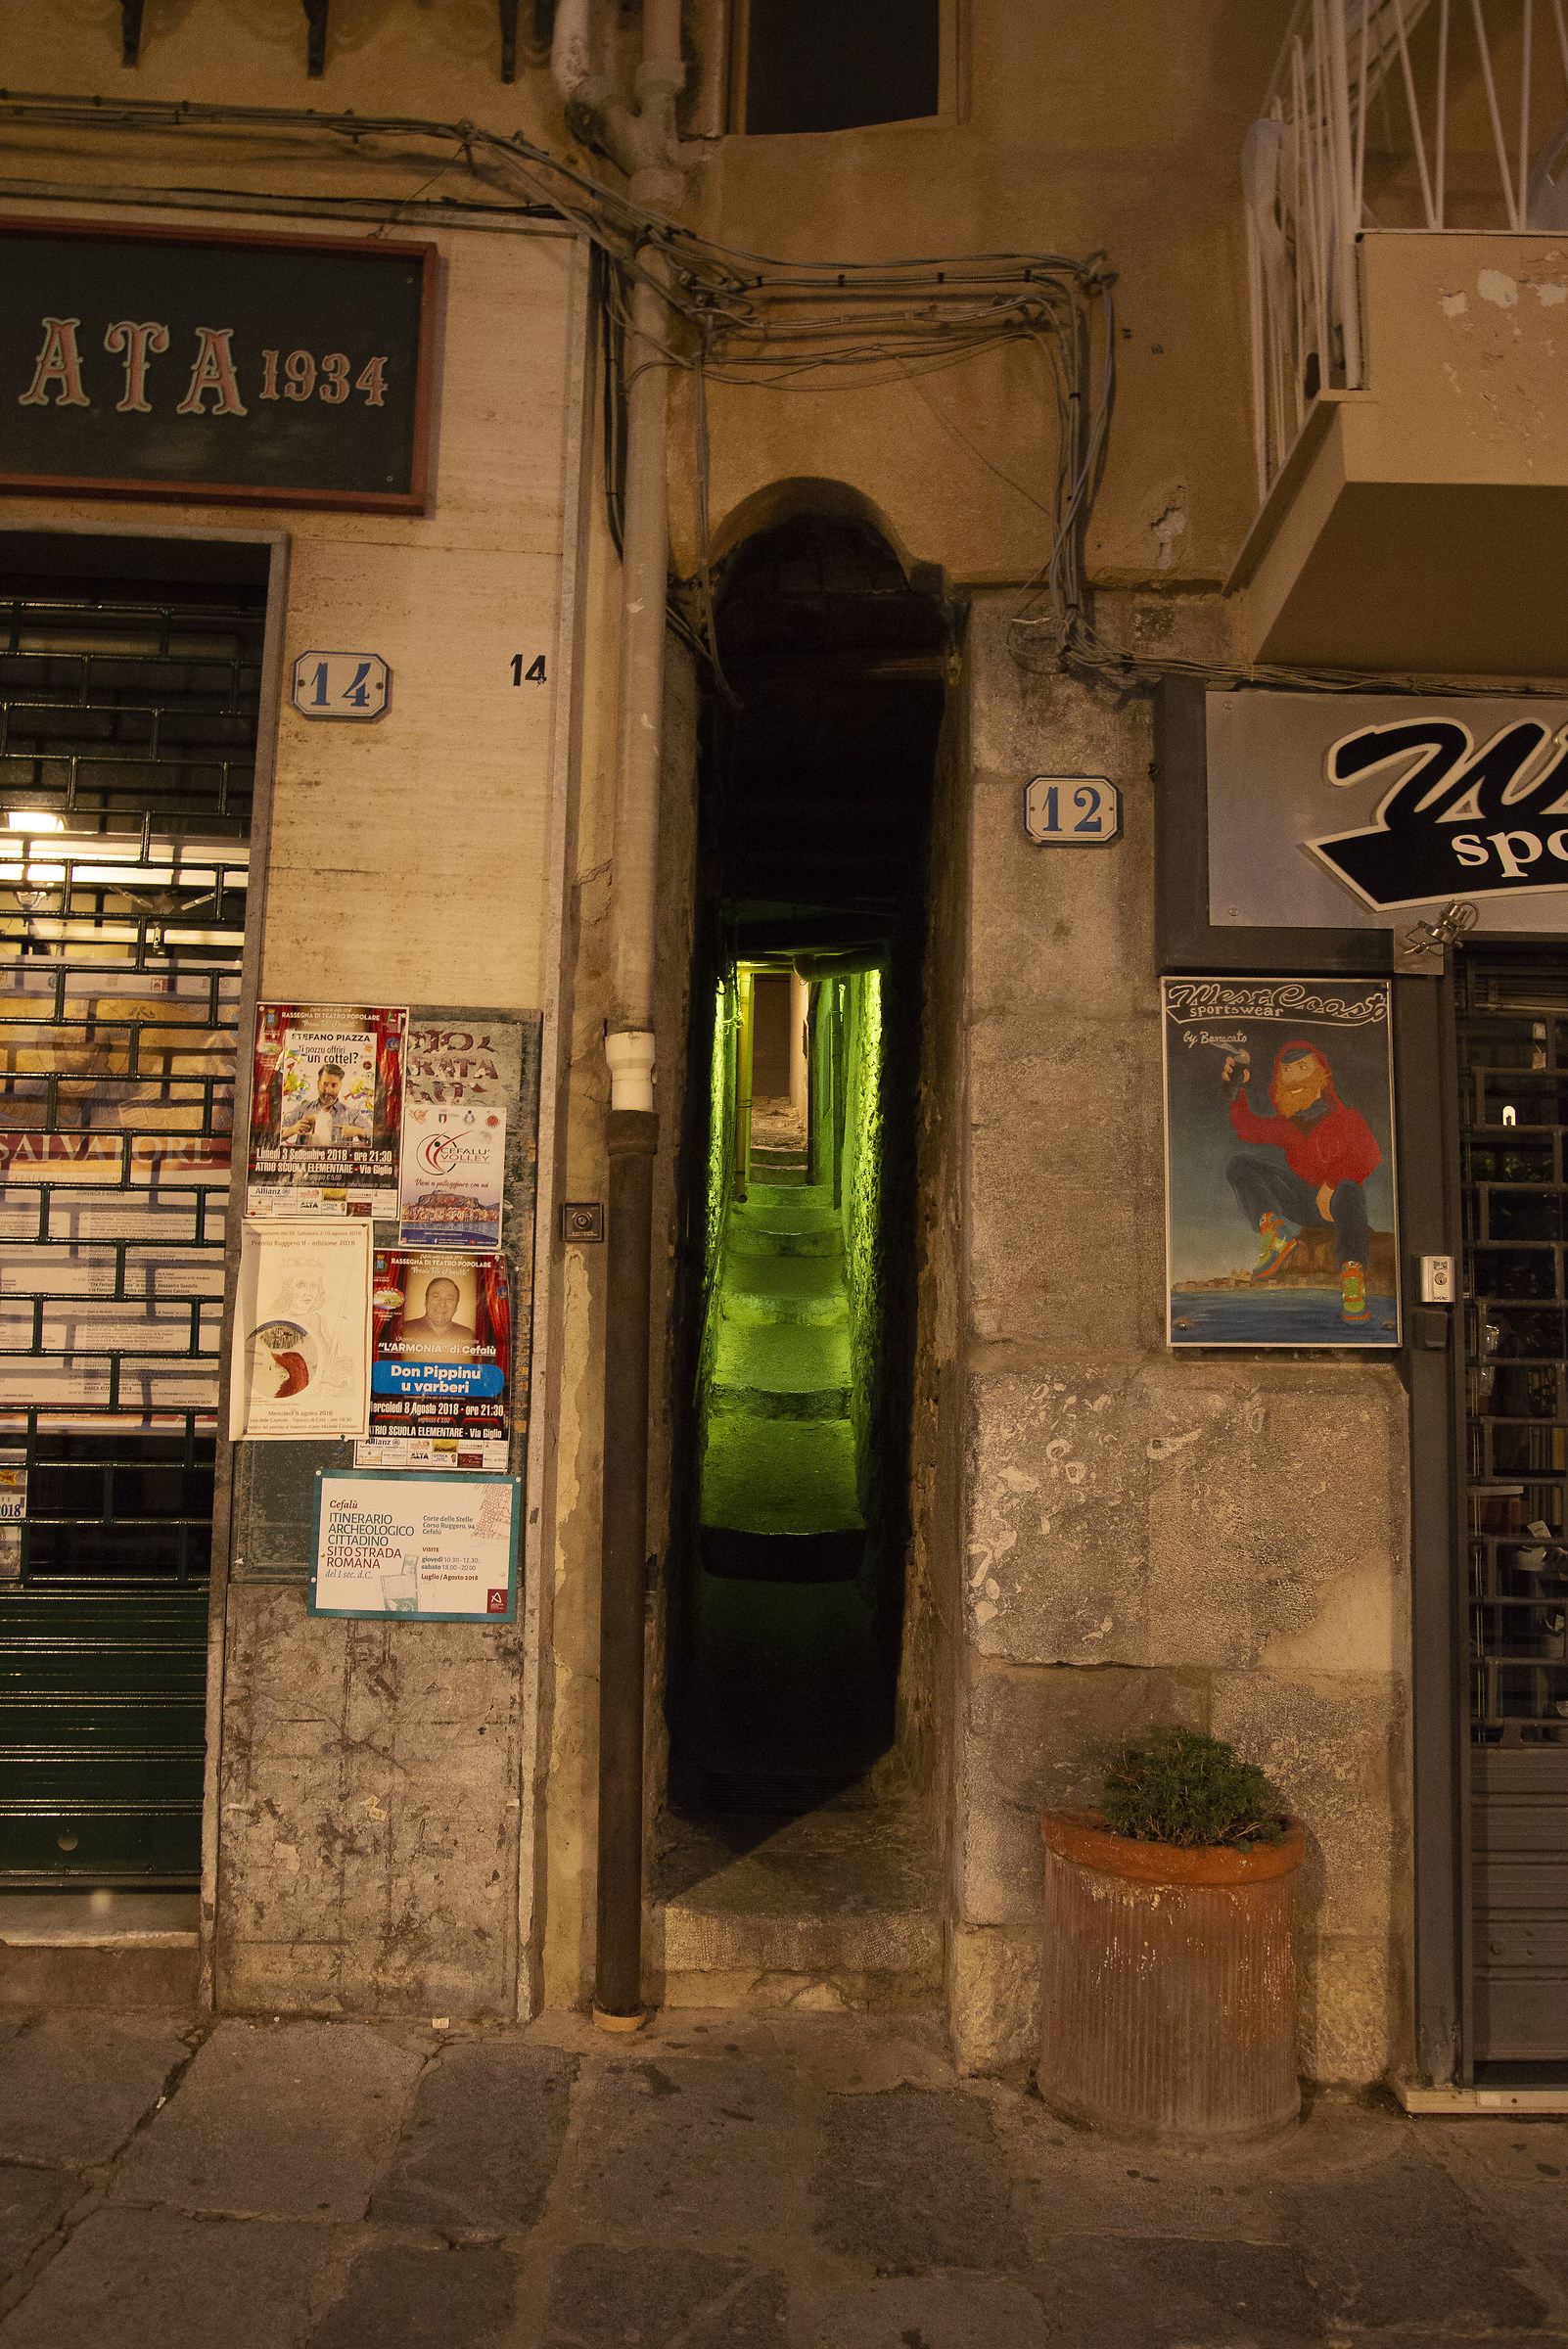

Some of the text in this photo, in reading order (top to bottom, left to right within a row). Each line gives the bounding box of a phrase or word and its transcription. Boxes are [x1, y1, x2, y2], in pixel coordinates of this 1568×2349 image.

[259, 349, 389, 406] 1934
[510, 654, 547, 686] 14
[310, 662, 371, 707] 14
[1042, 786, 1102, 832] 12
[1189, 1005, 1284, 1018] sportswear
[291, 1033, 334, 1041] STEFANO
[1183, 1031, 1198, 1048] by
[324, 1052, 359, 1064] cottel?
[256, 1147, 281, 1160] Lunedì
[282, 1149, 288, 1160] 3
[290, 1149, 325, 1161] Settembre
[327, 1149, 347, 1161] 2018
[353, 1152, 367, 1161] ore
[369, 1150, 392, 1162] 21:30
[255, 1162, 277, 1173] ATRIO
[278, 1163, 306, 1173] SCUOLA
[307, 1163, 353, 1174] ELEMENTARE
[360, 1164, 371, 1174] Via
[373, 1164, 392, 1175] Giglio
[415, 1177, 429, 1186] Vieni
[462, 1346, 496, 1355] Cefalù
[391, 1364, 482, 1380] Don Pippinu
[401, 1380, 470, 1393] u varberi
[370, 1401, 402, 1414] ercoledì
[404, 1403, 410, 1414] 8
[411, 1403, 437, 1416] Agosto
[438, 1403, 459, 1415] 2018
[465, 1406, 480, 1416] ore
[481, 1405, 504, 1416] 21:30
[389, 1426, 416, 1436] SCUOLA
[418, 1426, 464, 1437] ELEMENTARE
[470, 1428, 481, 1438] Via
[483, 1428, 502, 1439] Giglio
[0, 1504, 21, 1517] 018
[330, 1499, 358, 1511] Cefalù
[329, 1512, 393, 1525] ITINERARIO
[328, 1523, 415, 1537] ARCHEOLOGICO
[327, 1534, 390, 1546] CITTADINO
[326, 1545, 402, 1558] SITO STRADA
[326, 1556, 381, 1569] ROMANA
[324, 1569, 337, 1578] del
[357, 1570, 373, 1580] d.C.
